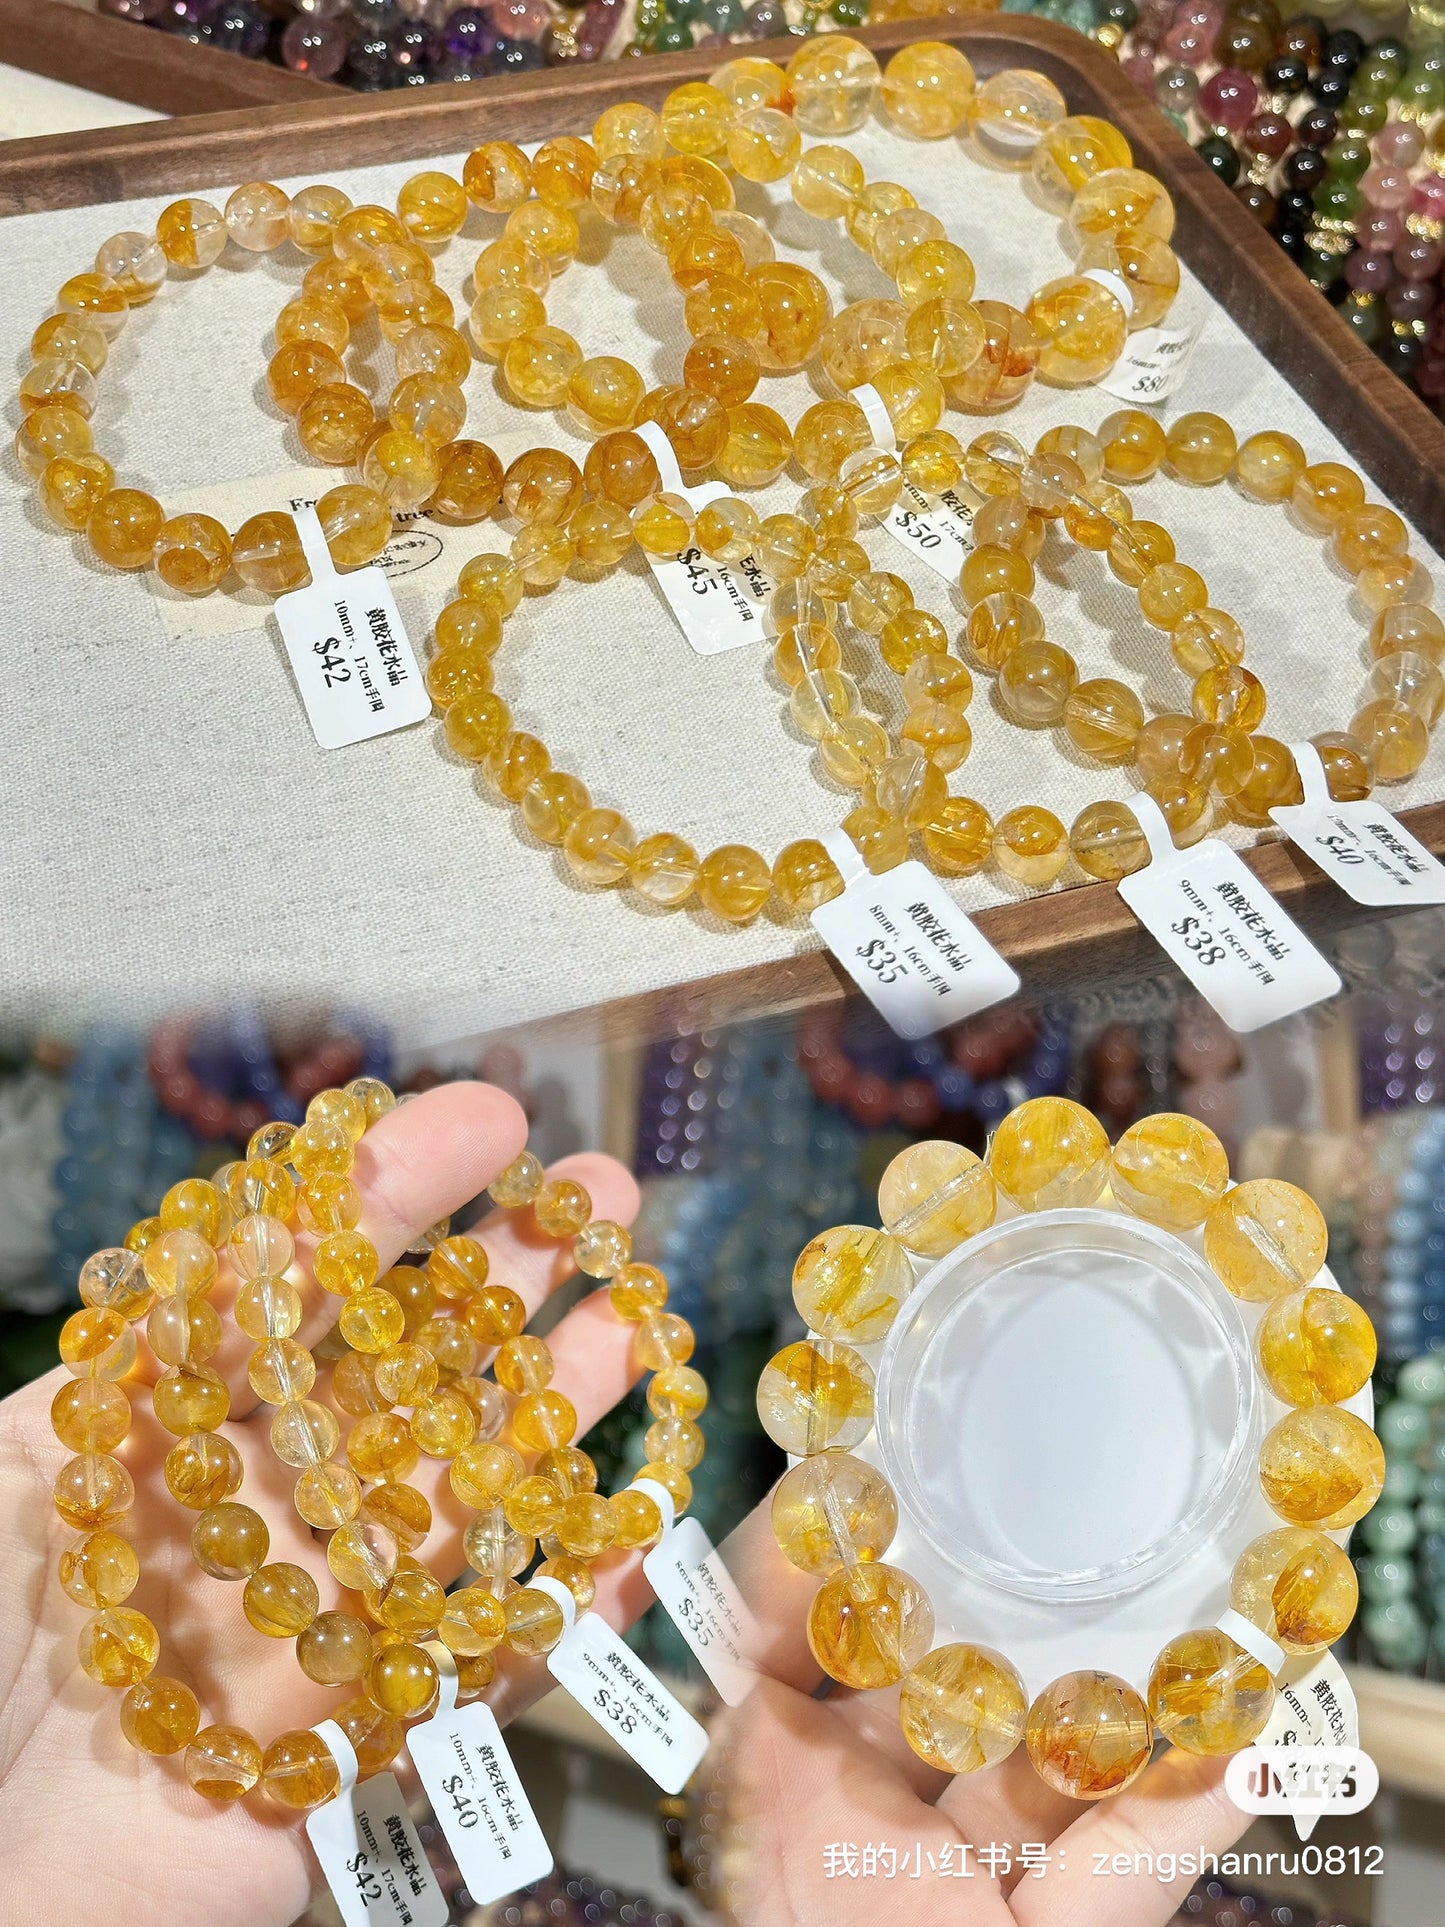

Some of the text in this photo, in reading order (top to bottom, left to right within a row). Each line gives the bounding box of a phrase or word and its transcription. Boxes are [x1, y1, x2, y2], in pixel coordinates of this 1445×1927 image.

[896, 511, 942, 549] $50
[676, 548, 719, 596] $45
[311, 636, 352, 689] $42
[1314, 835, 1365, 865] $40
[855, 937, 910, 984] $35
[1171, 915, 1227, 966] $38
[678, 1597, 715, 1647] $35
[592, 1687, 639, 1736] $38
[441, 1773, 480, 1829] $40
[345, 1851, 383, 1908] $42
